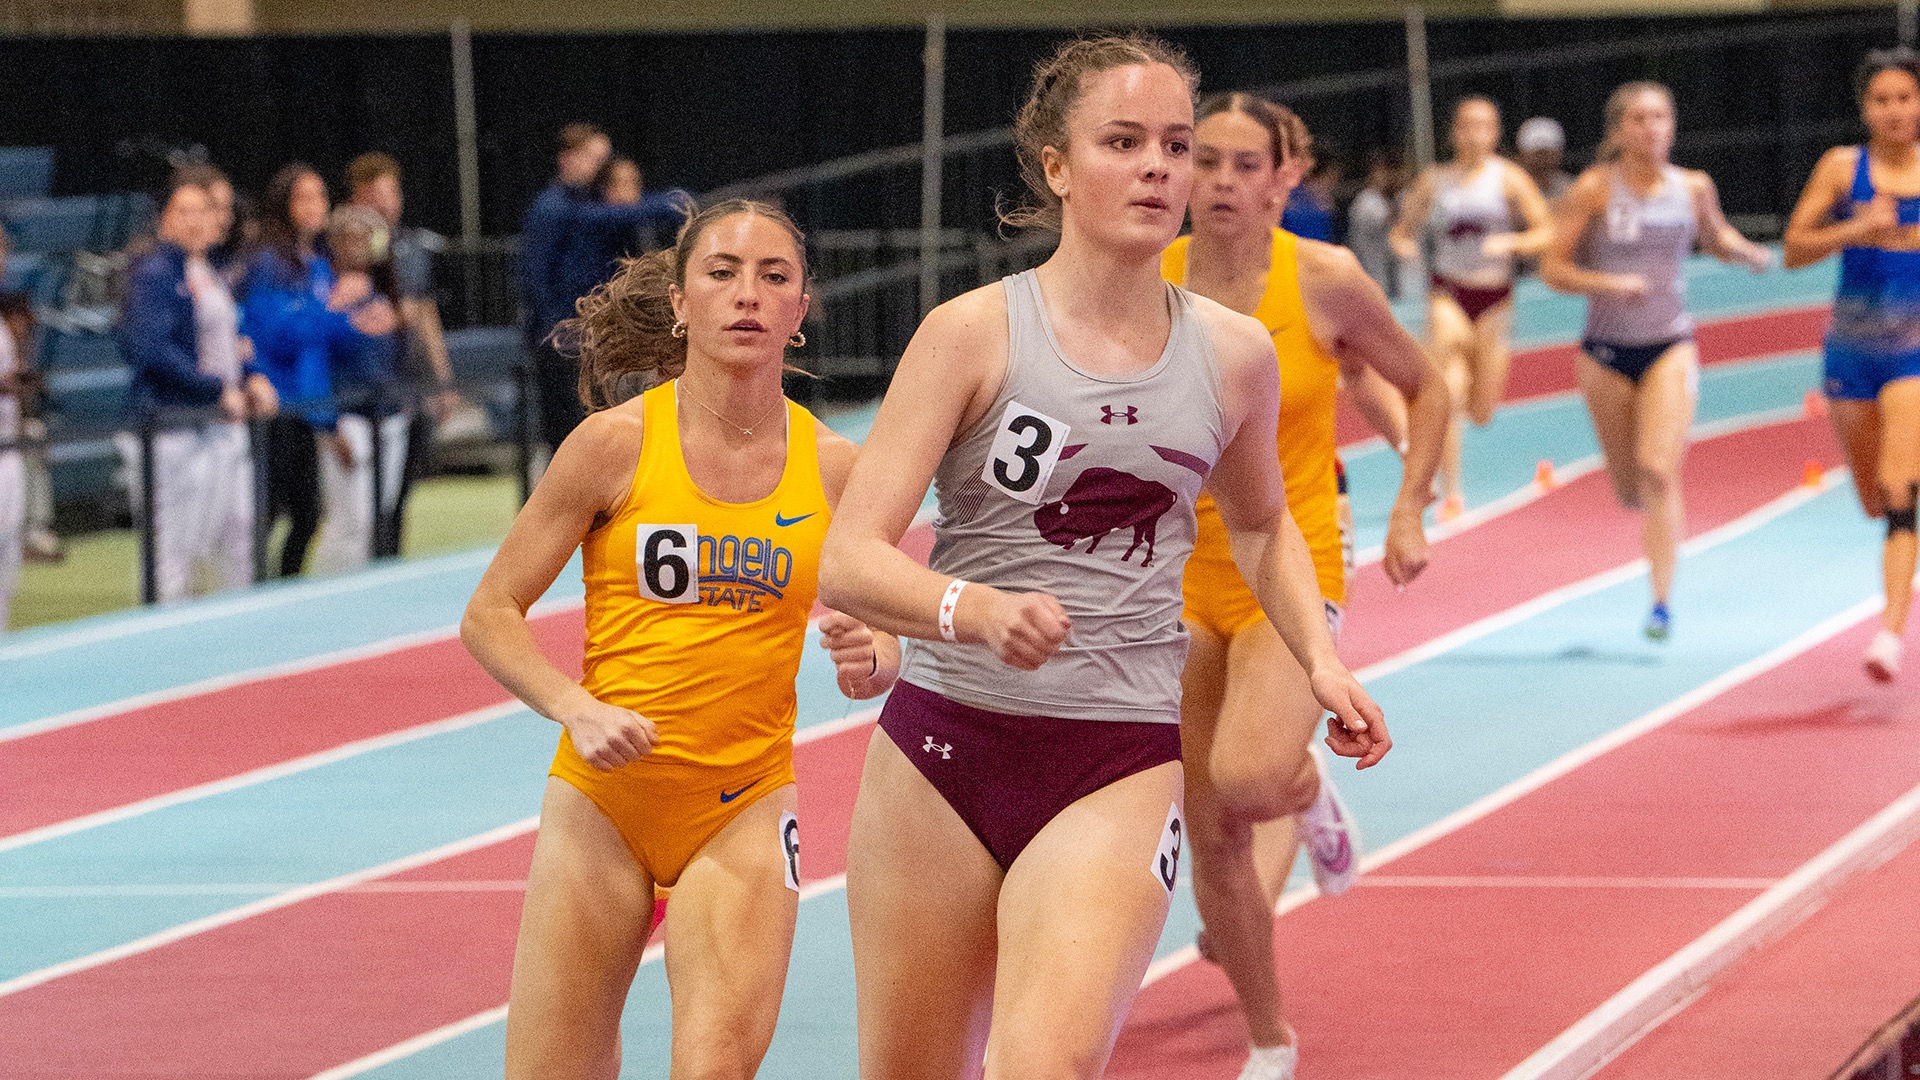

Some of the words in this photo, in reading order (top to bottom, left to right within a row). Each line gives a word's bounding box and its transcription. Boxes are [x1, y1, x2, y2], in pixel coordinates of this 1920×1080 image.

[993, 415, 1052, 493] 3
[643, 529, 690, 599] 6
[697, 535, 792, 588] ngelo
[1160, 818, 1181, 892] 3
